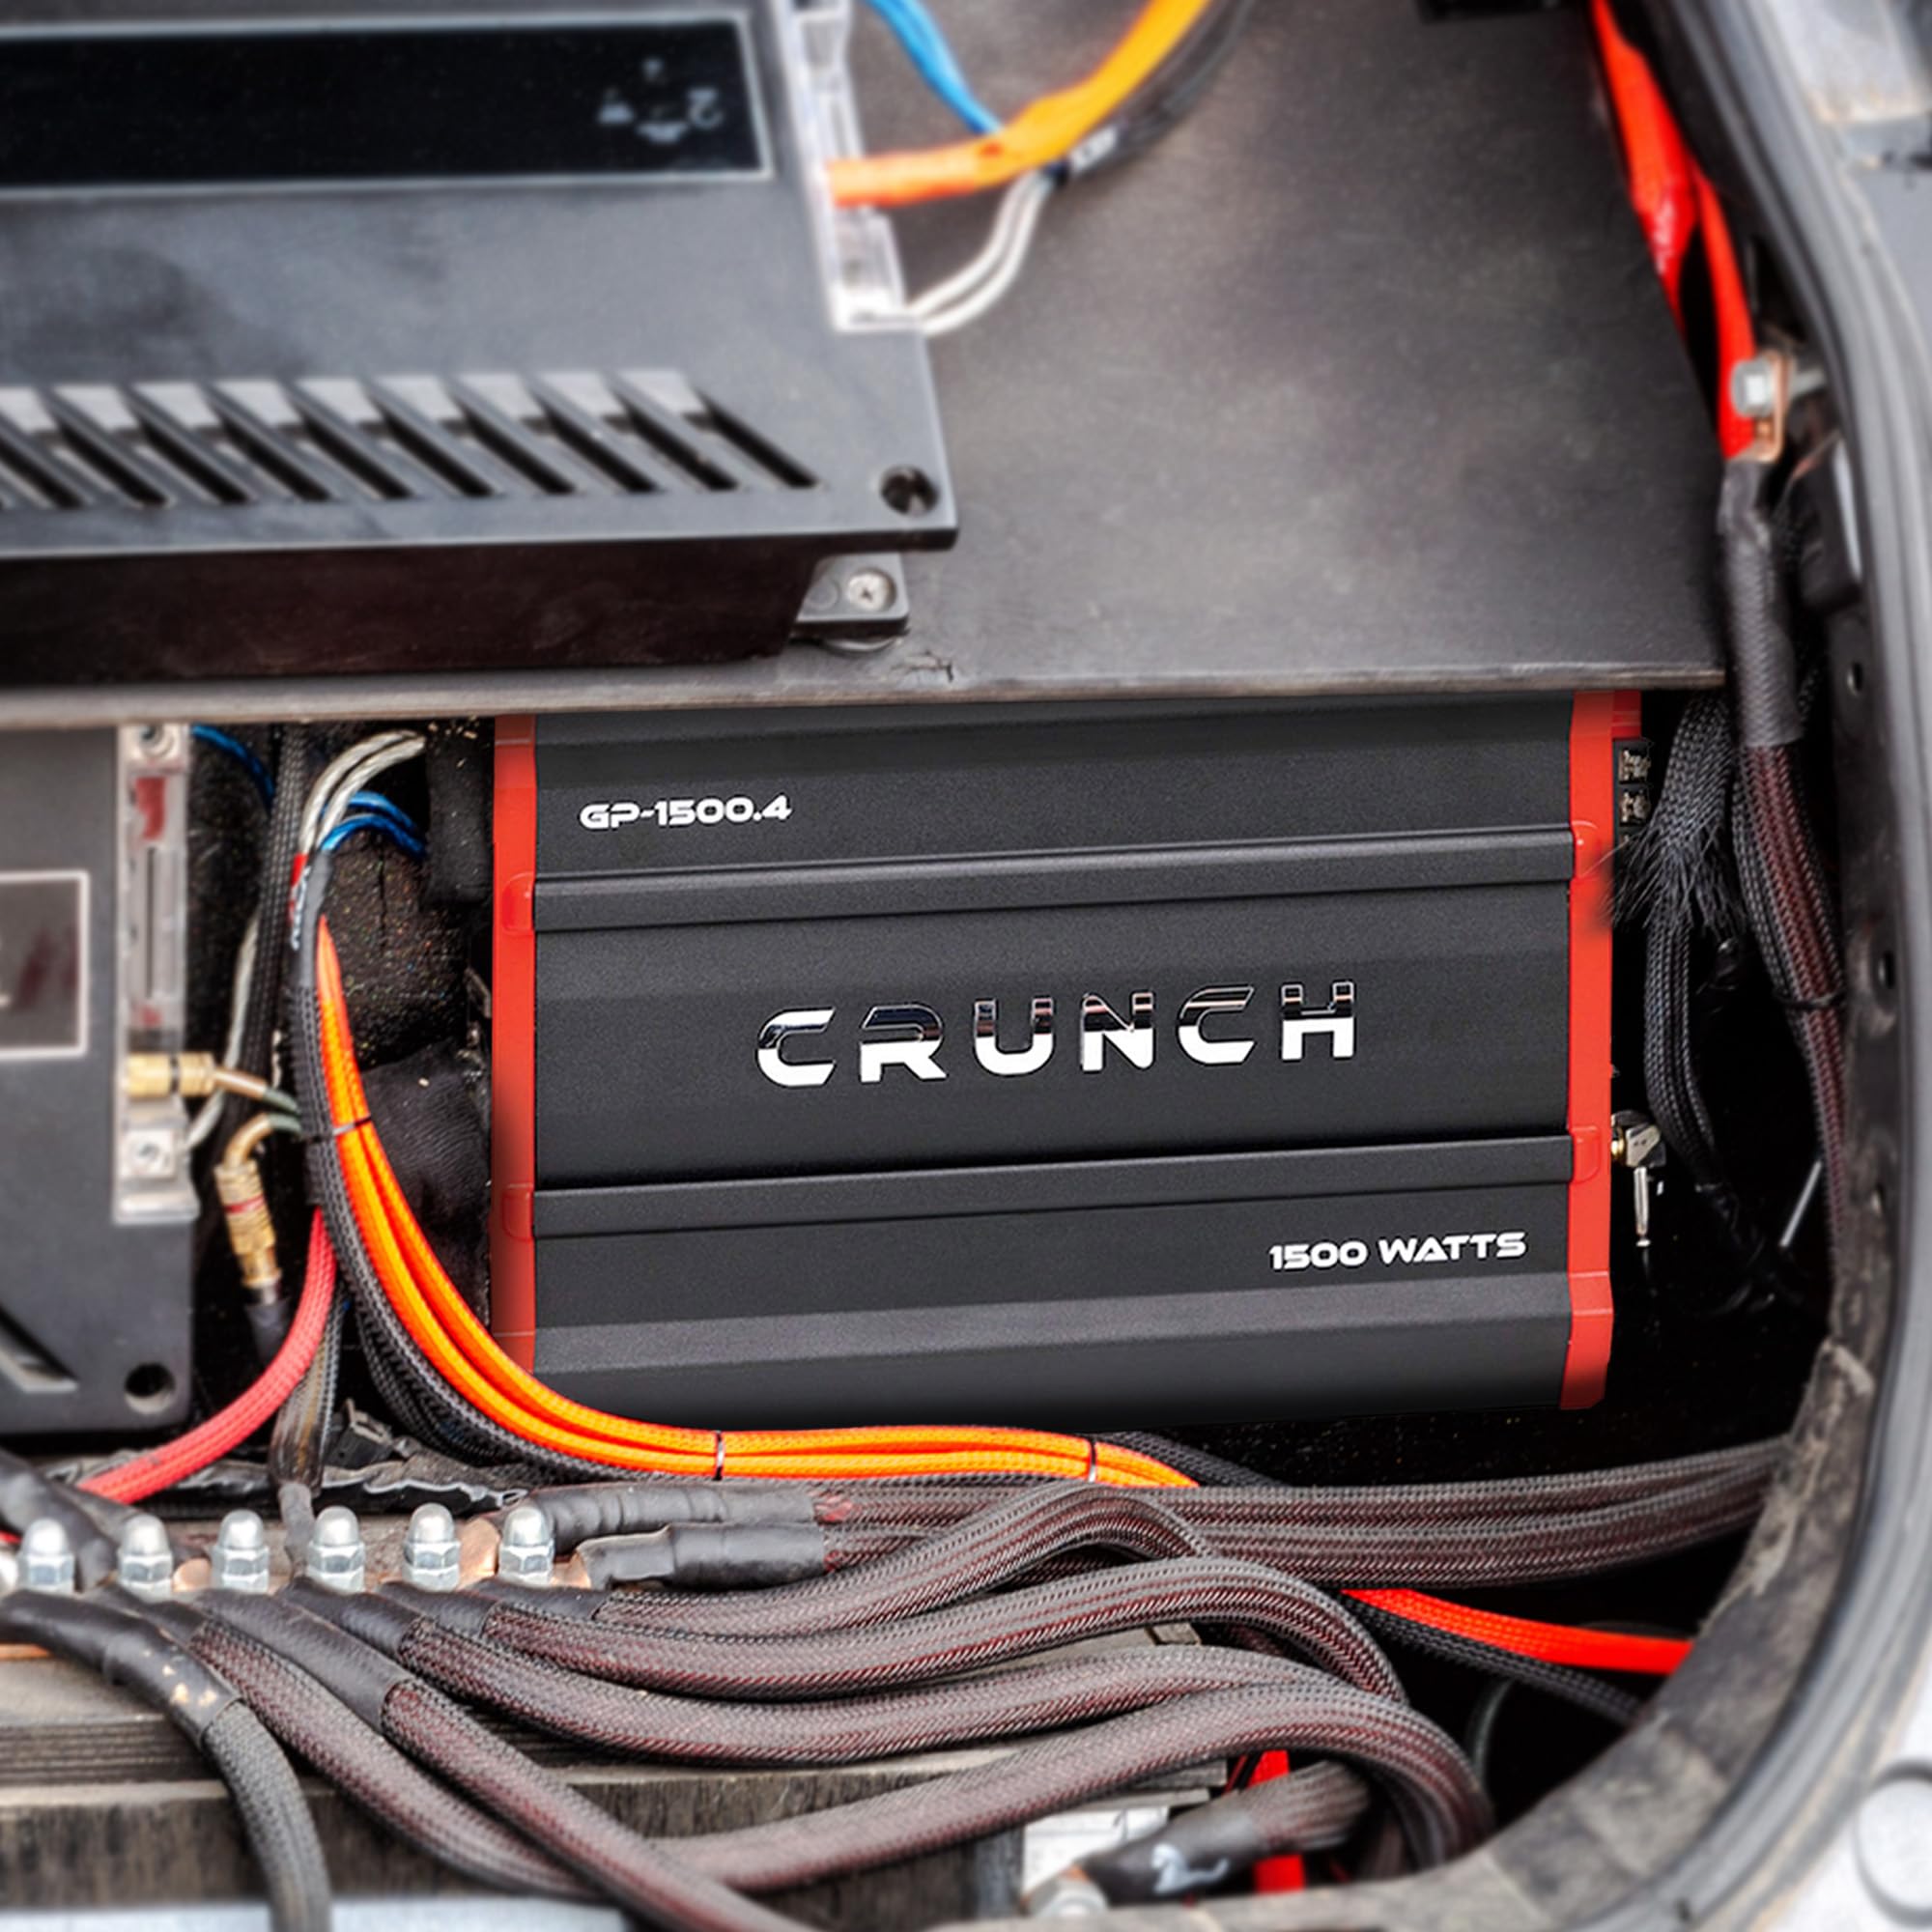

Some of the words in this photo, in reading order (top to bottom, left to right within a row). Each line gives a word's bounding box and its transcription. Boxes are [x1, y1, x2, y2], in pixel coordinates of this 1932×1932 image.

[579, 794, 792, 830] GP-1500.4
[756, 980, 1354, 1087] CRUNCH
[1268, 1240, 1369, 1270] 1500
[1378, 1231, 1527, 1264] WATTS
